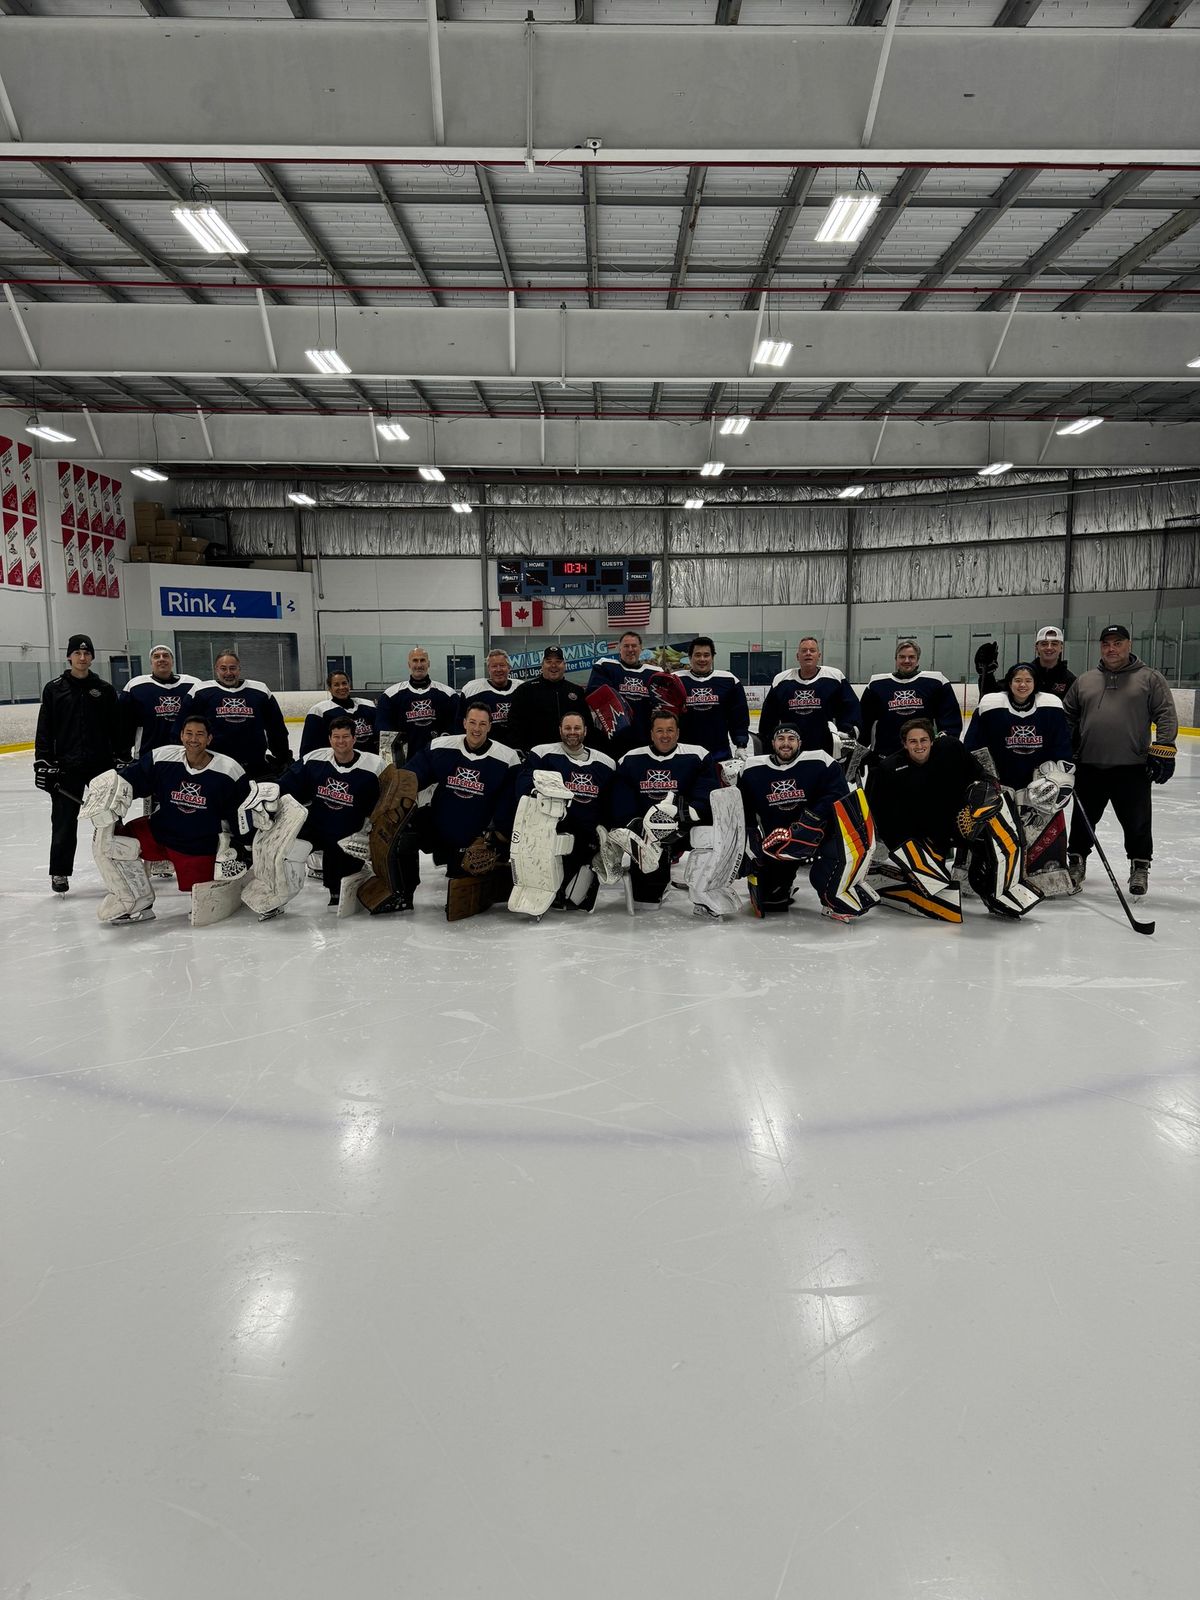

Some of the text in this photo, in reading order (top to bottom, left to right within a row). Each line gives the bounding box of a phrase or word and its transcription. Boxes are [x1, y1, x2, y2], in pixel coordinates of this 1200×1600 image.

[564, 562, 588, 574] 10:34
[168, 591, 237, 614] Rink 4
[562, 640, 609, 660] WING
[508, 671, 518, 680] oin
[565, 661, 578, 671] fter
[578, 659, 591, 669] the
[728, 853, 743, 885] BAUER
